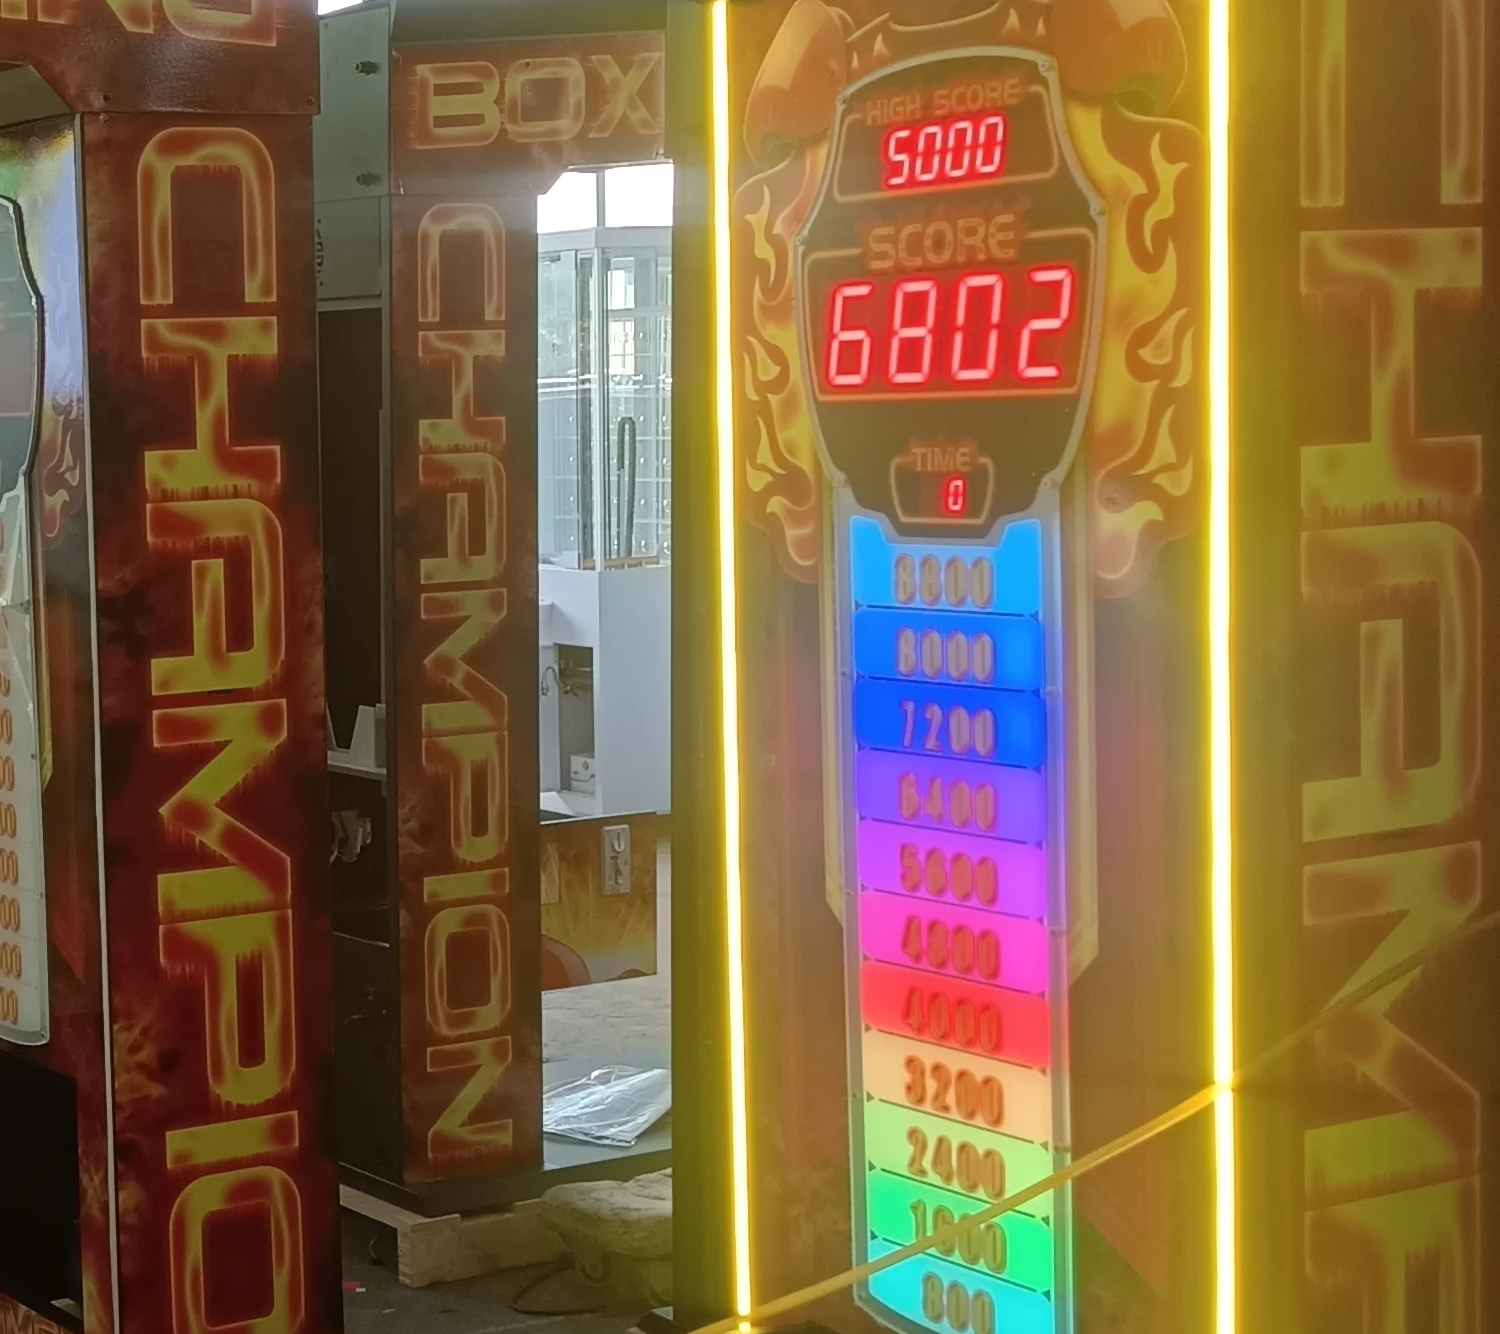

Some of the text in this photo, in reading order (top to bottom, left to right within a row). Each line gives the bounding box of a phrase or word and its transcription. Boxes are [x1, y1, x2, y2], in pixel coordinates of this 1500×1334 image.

[865, 77, 1023, 125] HIGH SCORE
[884, 114, 1007, 189] 5000
[868, 213, 1017, 270] SCORE
[824, 266, 1076, 389] 6802
[910, 445, 972, 474] TIME
[943, 478, 967, 515] 0
[418, 202, 515, 1164] CHAMPION
[899, 699, 998, 759] 7200
[899, 771, 999, 833] 6400
[904, 985, 1003, 1055] 4000
[903, 1055, 1006, 1129] 3200
[906, 1126, 1007, 1200] 2400
